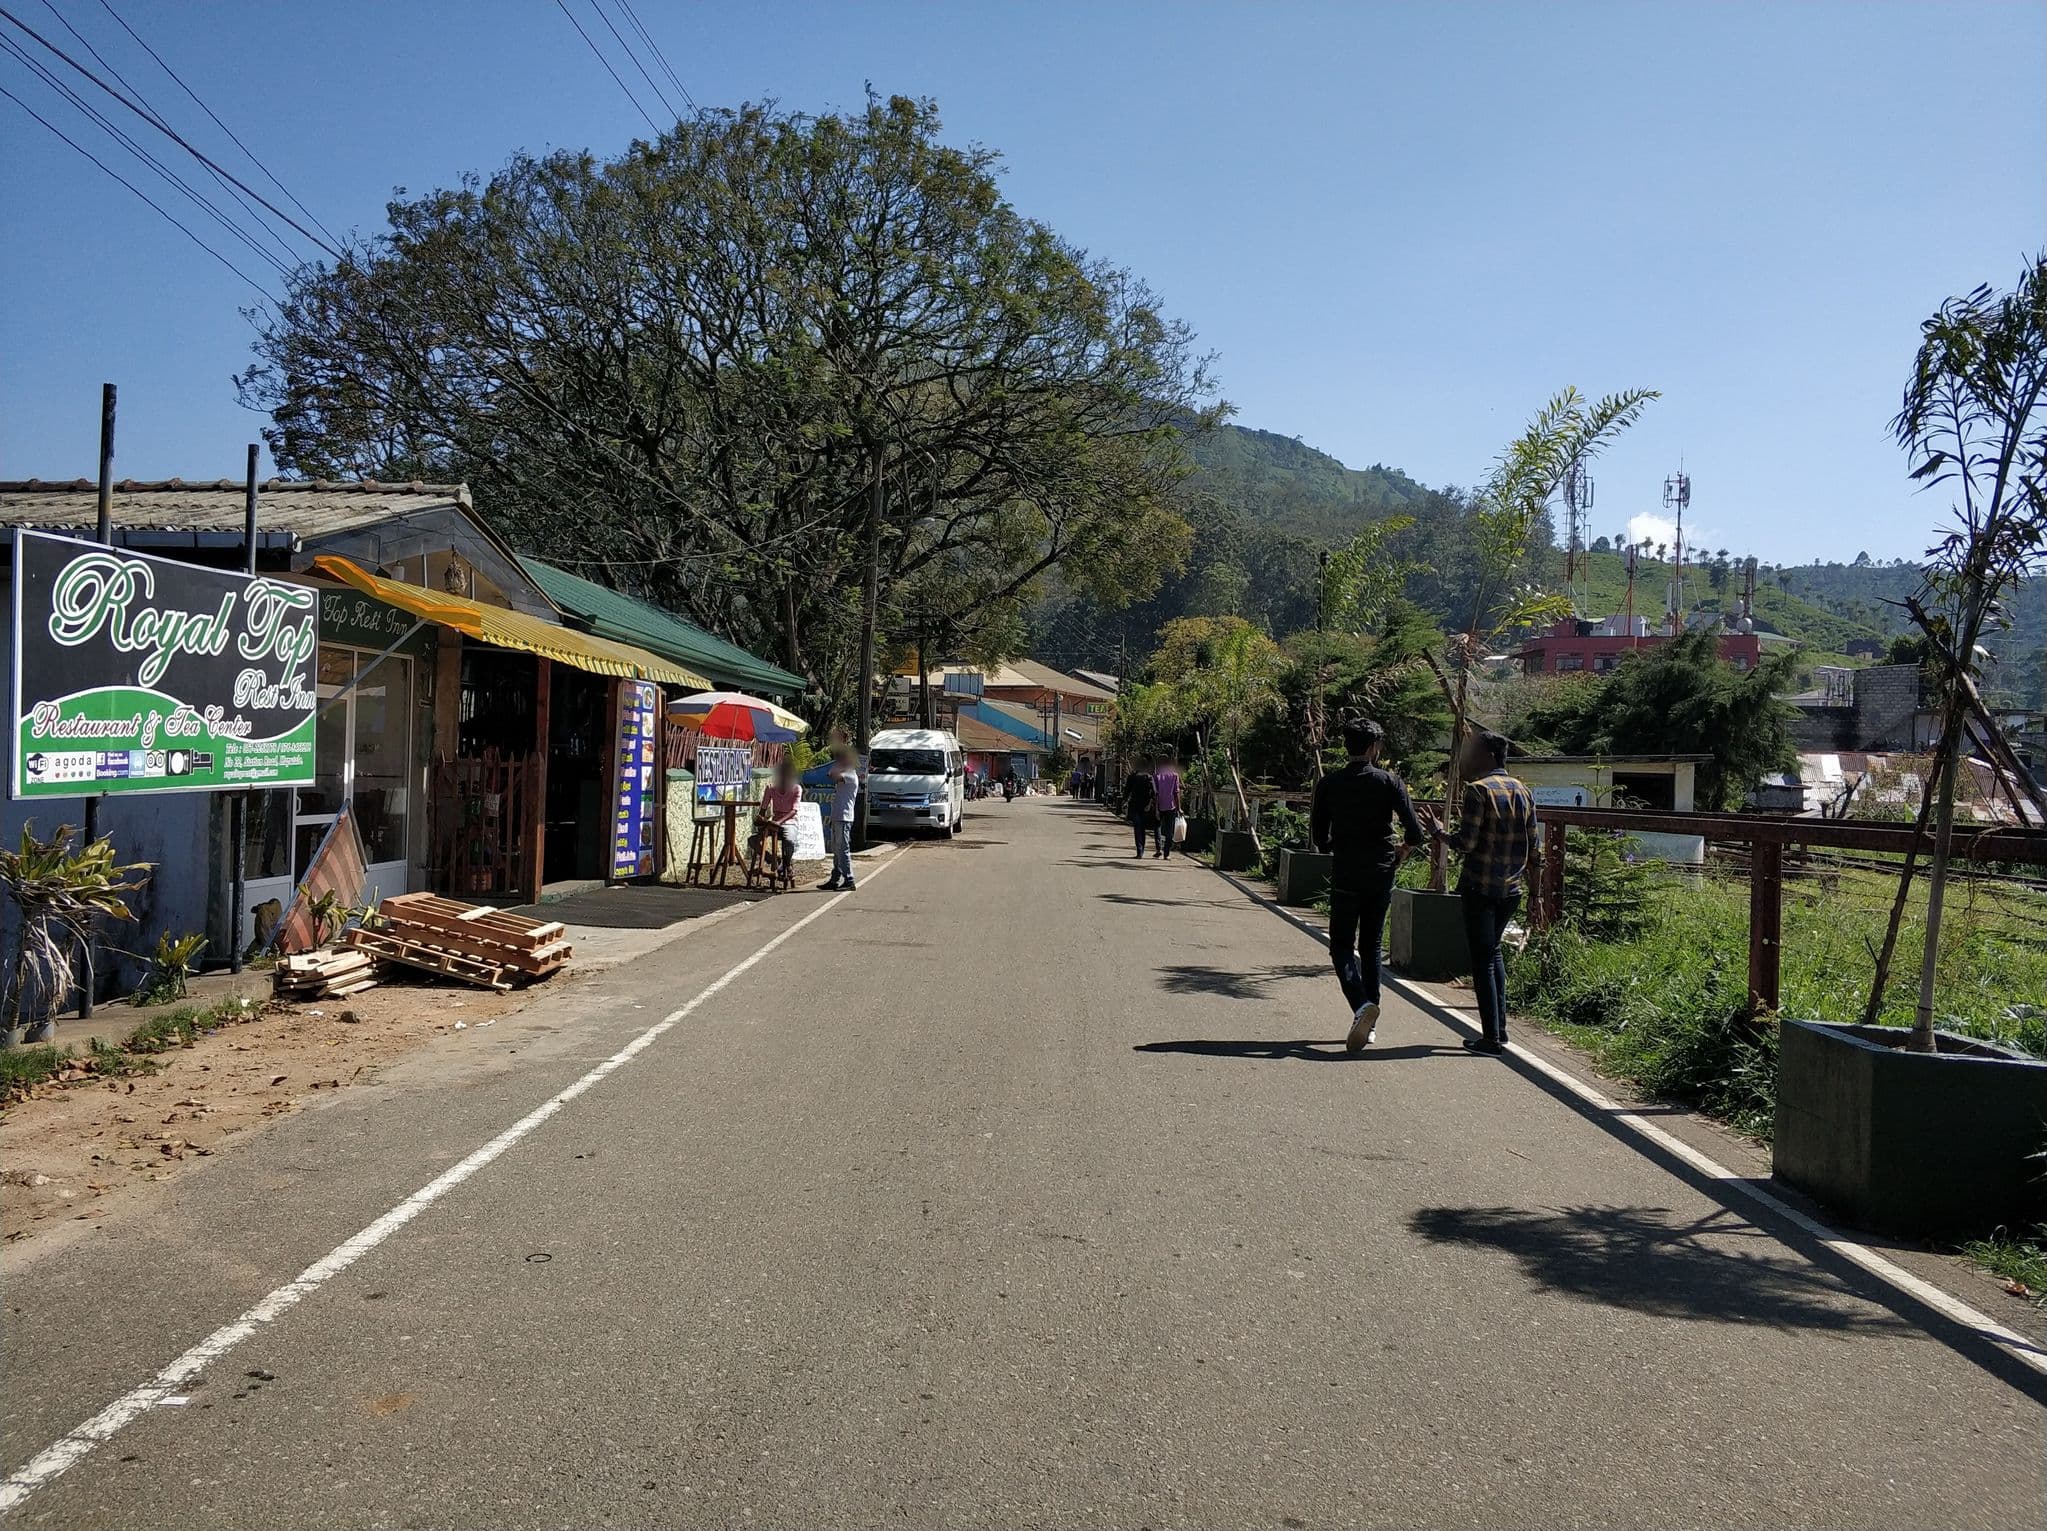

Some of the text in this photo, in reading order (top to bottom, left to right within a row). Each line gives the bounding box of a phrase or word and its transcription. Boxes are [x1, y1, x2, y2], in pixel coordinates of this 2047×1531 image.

[49, 552, 316, 689] Royal Top
[322, 594, 409, 635] Top Rest Inn
[233, 668, 316, 710] Rest Inn
[31, 701, 252, 748] Restaurant & Tea Center
[54, 755, 92, 769] agoda
[697, 750, 752, 785] RESTAURANT
